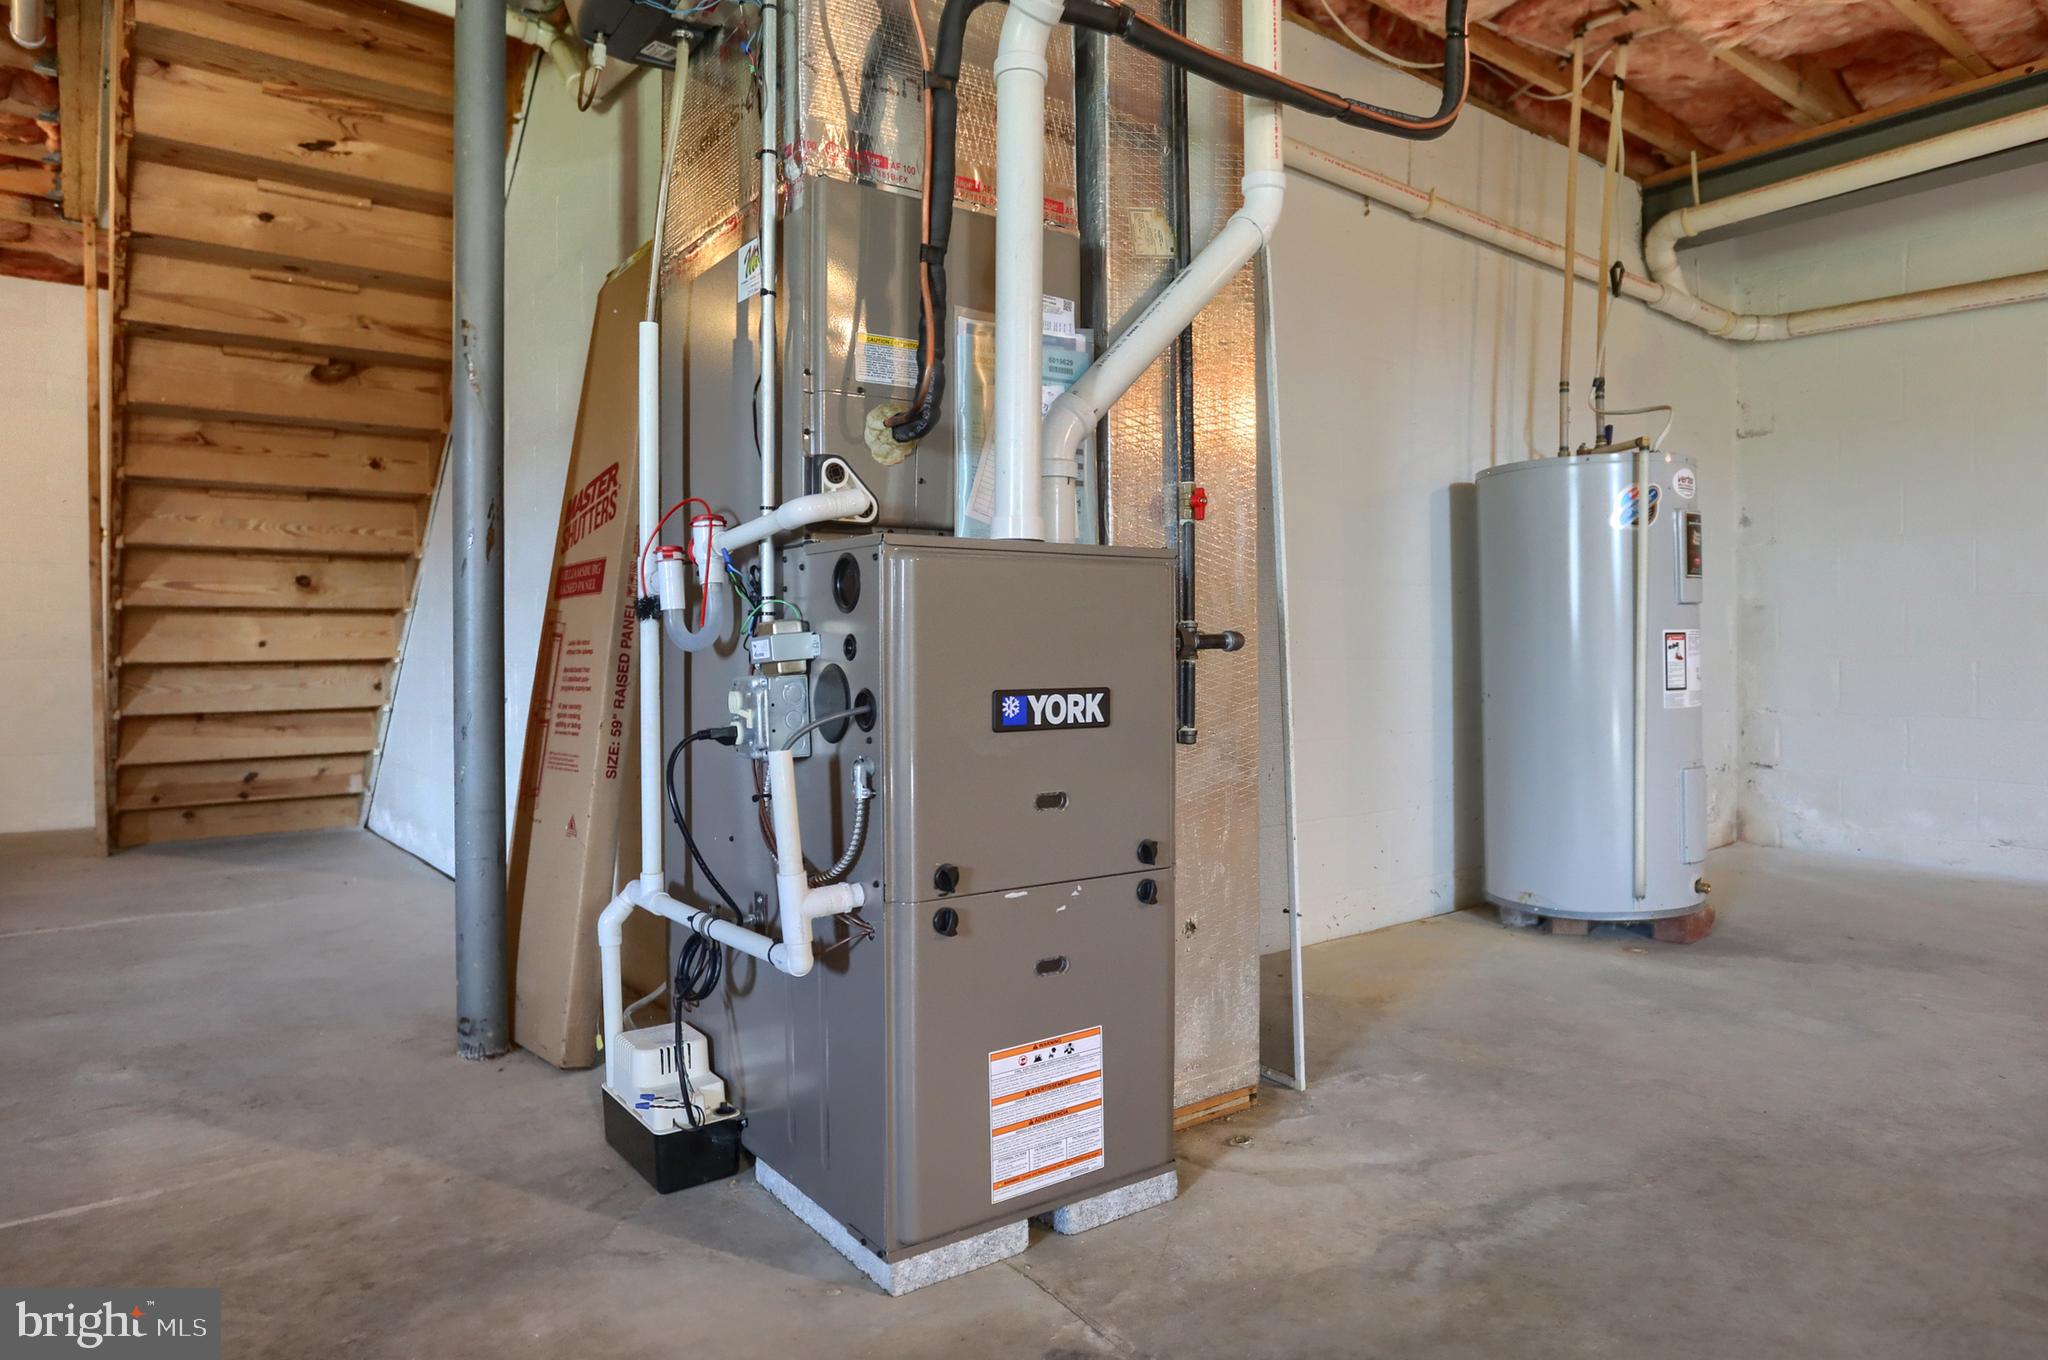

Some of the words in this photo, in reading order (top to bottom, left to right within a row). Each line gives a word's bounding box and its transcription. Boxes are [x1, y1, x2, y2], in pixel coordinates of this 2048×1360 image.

[565, 461, 620, 526] MASTER
[560, 488, 619, 555] SHUTTERS
[614, 652, 631, 710] RAISED
[611, 713, 622, 738] 59"
[1026, 693, 1105, 726] YORK
[605, 740, 621, 780] SIZE:
[1038, 1037, 1062, 1050] WARNING
